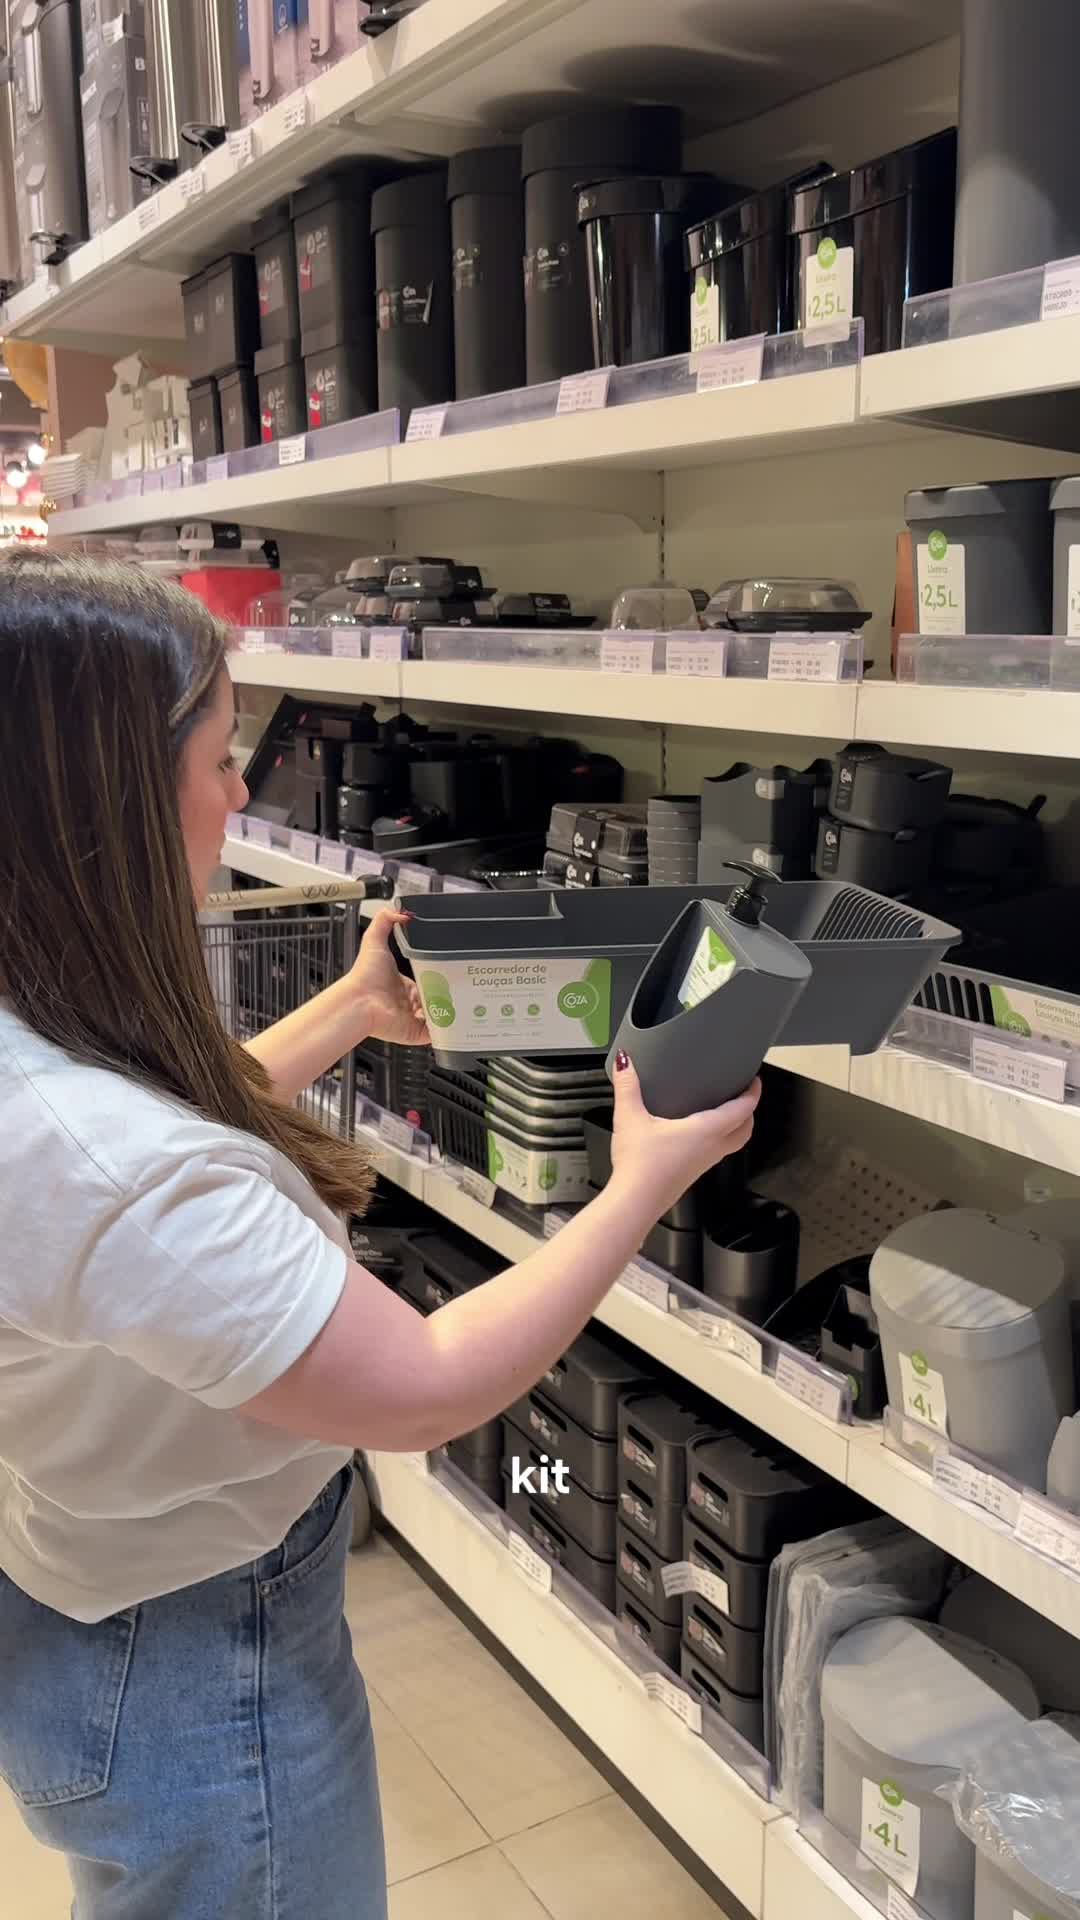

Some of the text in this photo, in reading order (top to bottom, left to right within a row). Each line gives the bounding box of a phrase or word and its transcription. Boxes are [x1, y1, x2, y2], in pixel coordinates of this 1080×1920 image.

[467, 964, 547, 975] Escorredor de
[472, 975, 547, 988] Louças Basic
[563, 992, 588, 1009] COZA
